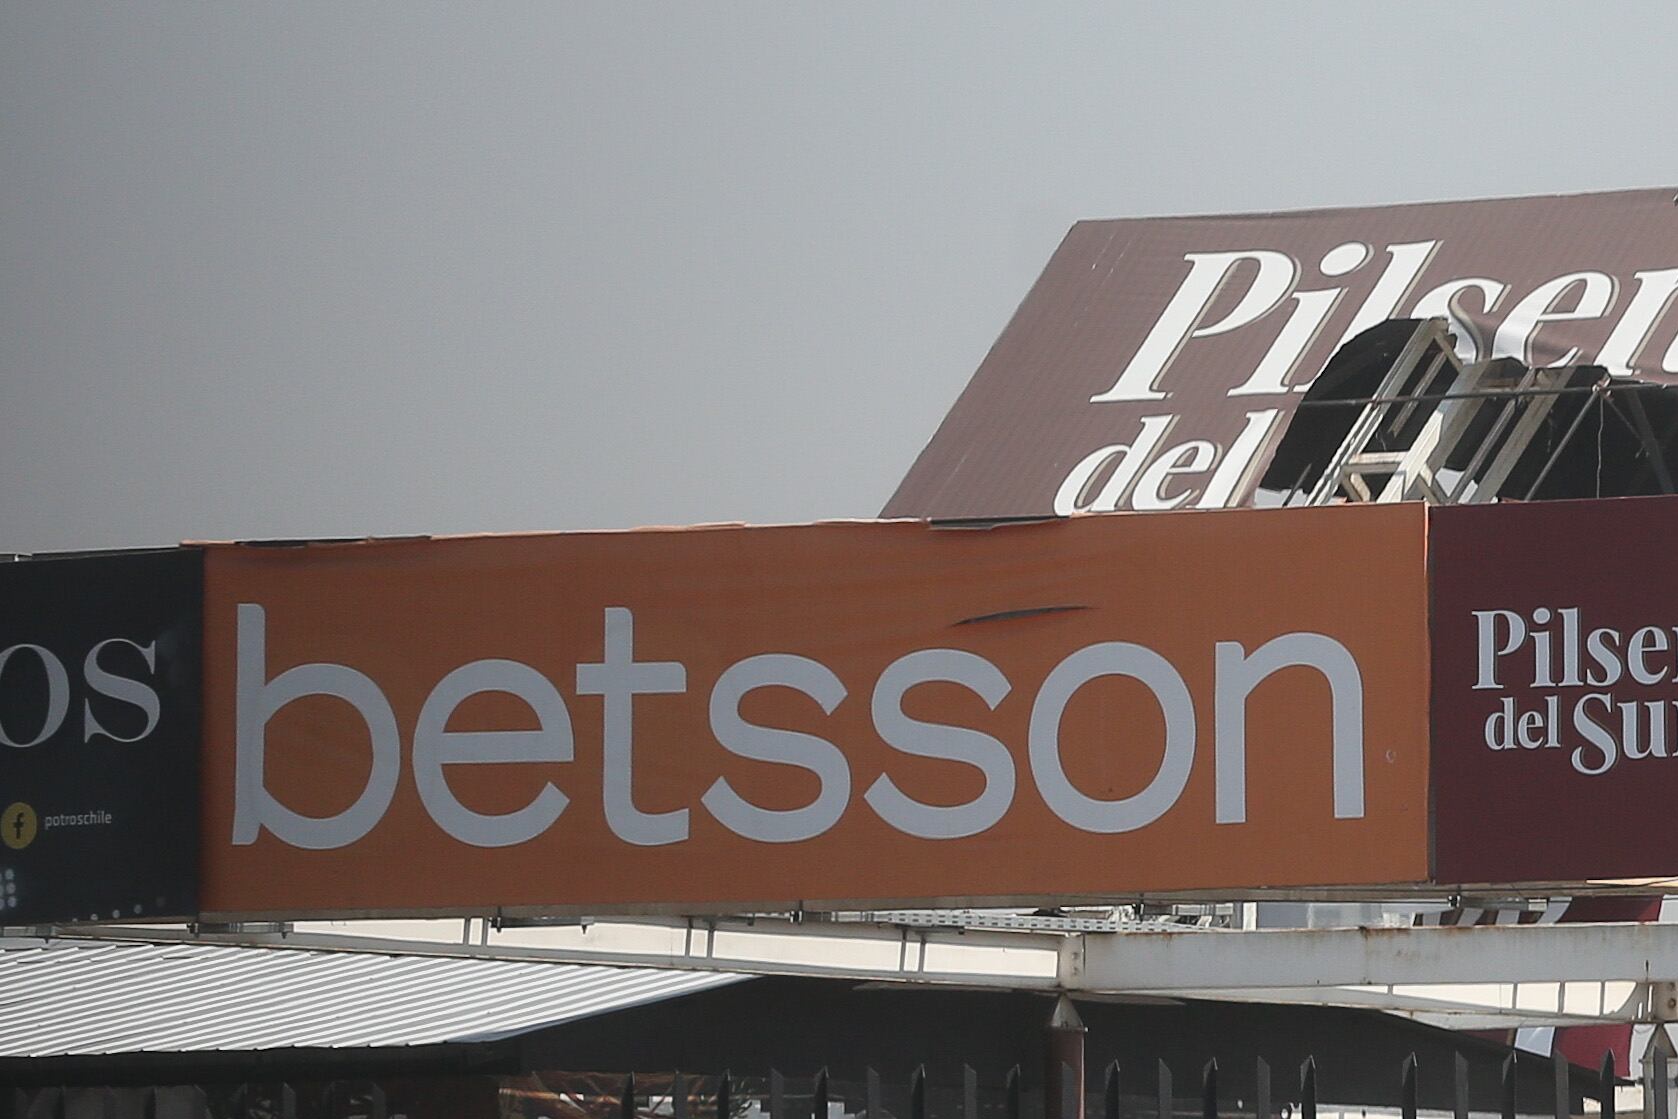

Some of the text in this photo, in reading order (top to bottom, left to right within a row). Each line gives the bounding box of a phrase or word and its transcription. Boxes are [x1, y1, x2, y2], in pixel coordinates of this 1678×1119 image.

[1054, 407, 1285, 517] del
[231, 602, 1366, 851] betsson
[1484, 694, 1562, 751] del
[44, 810, 113, 830] potroschile
